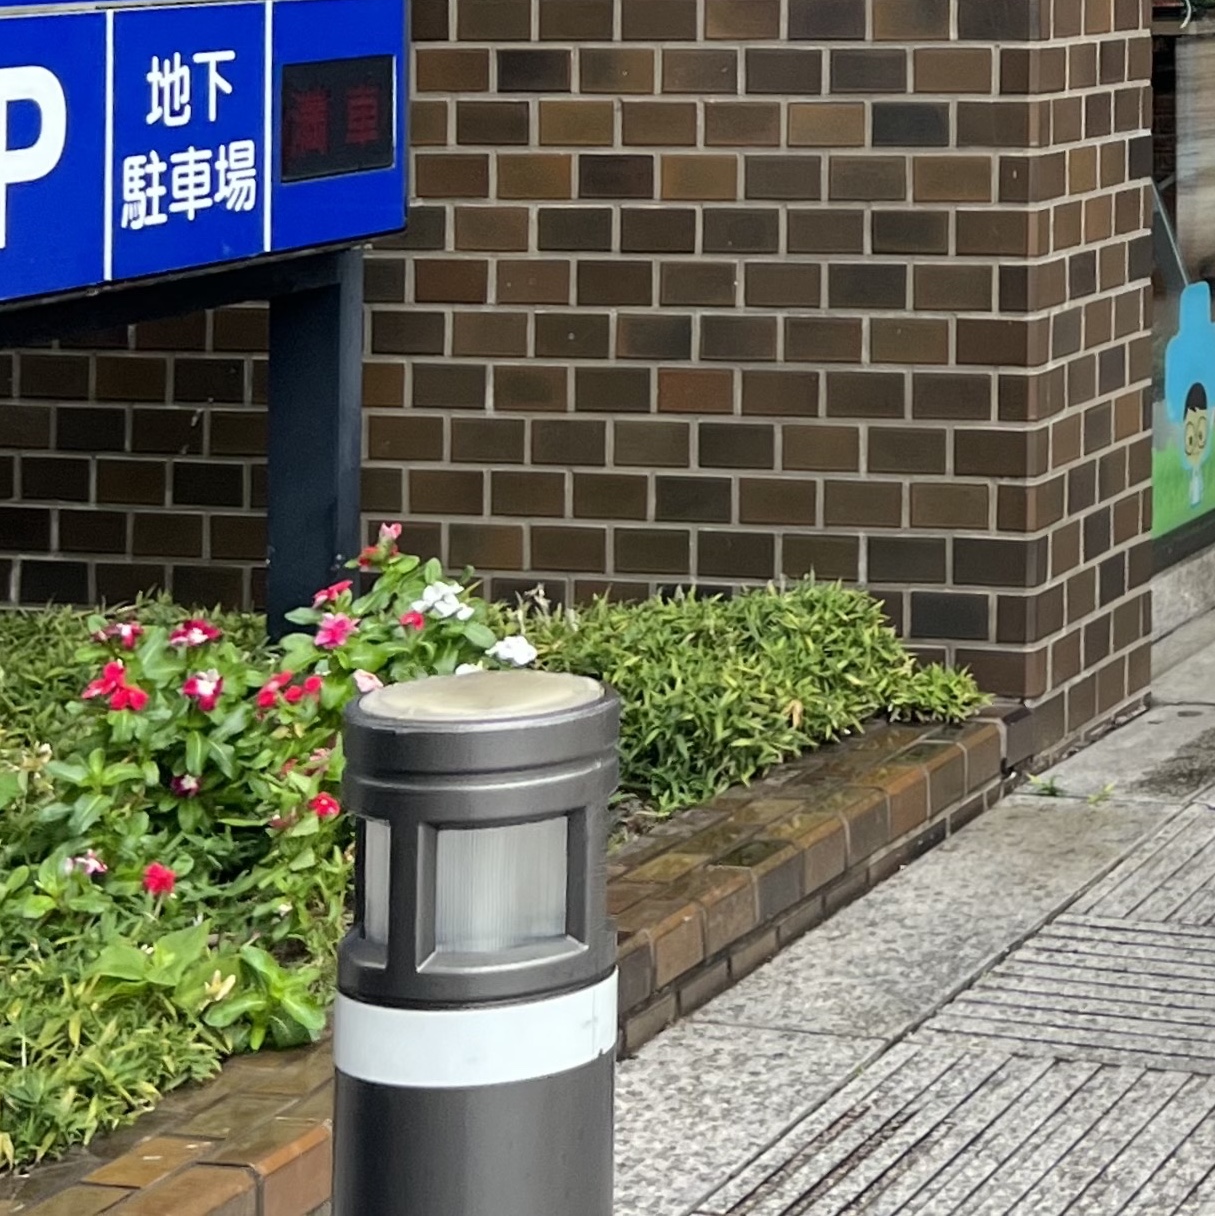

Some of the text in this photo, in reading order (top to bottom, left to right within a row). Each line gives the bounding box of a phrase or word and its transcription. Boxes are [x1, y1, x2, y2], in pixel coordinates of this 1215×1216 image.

[145, 50, 236, 128] 地下
[120, 144, 257, 230] 駐車場
